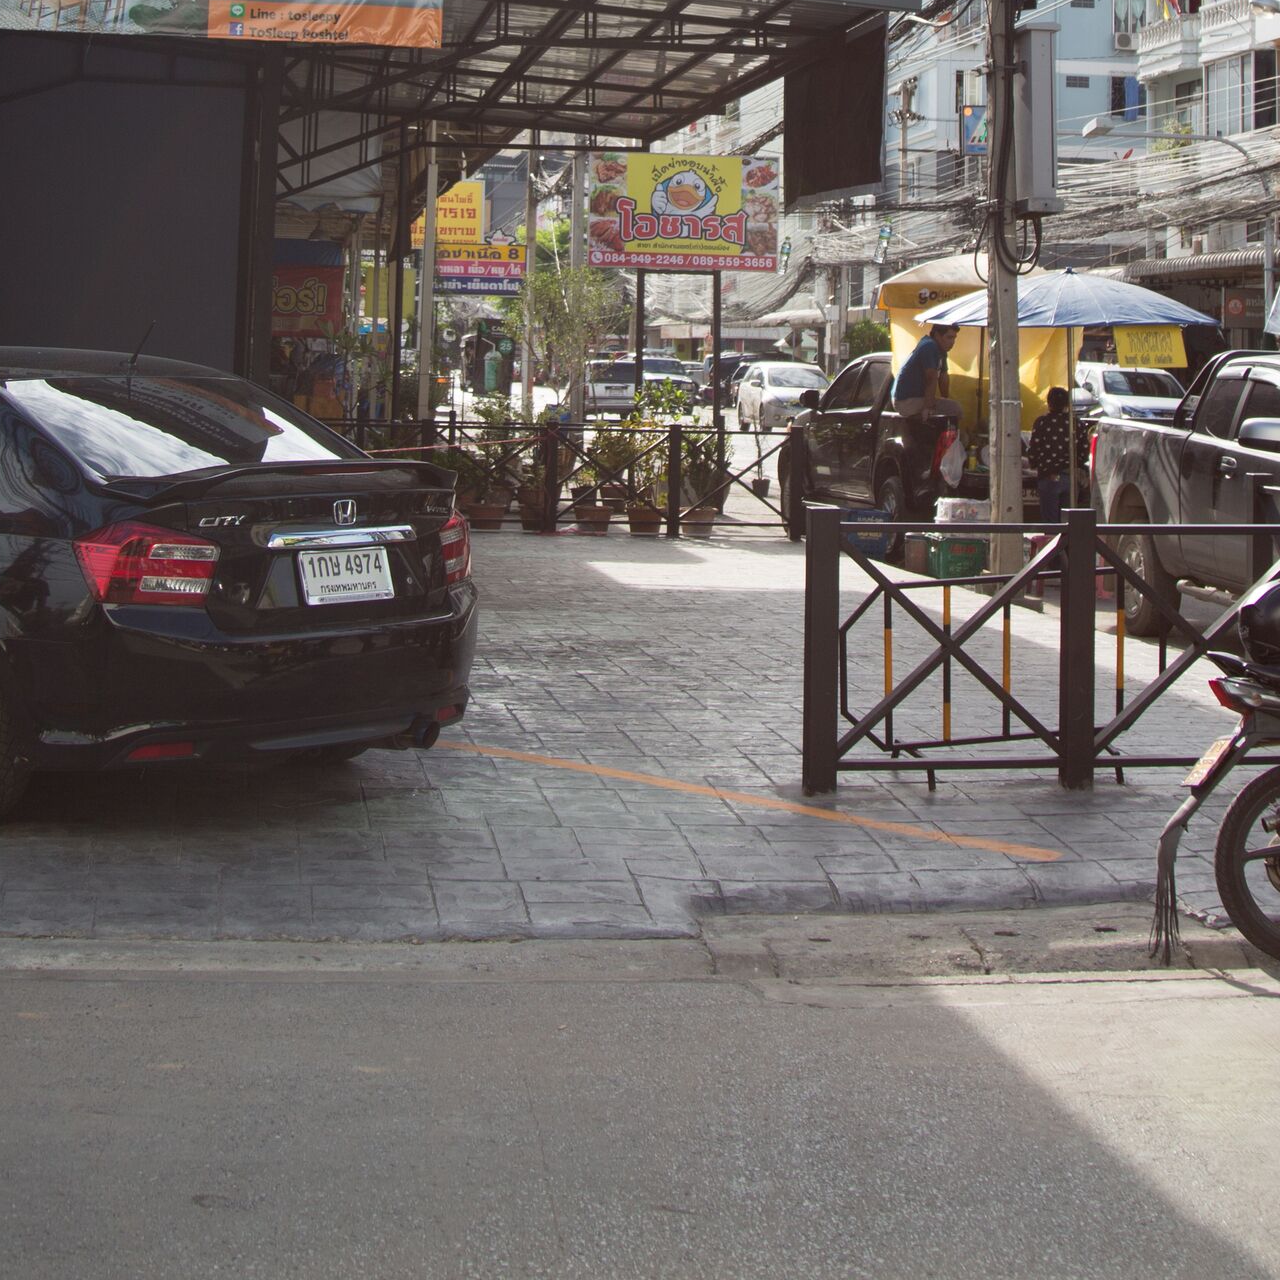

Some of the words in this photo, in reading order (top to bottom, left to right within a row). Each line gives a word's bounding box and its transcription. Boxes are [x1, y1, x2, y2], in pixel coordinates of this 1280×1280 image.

[250, 8, 276, 20] Line
[288, 11, 341, 24] tosleepy
[249, 27, 298, 40] ToSleep
[302, 28, 348, 41] Poshtel
[617, 196, 749, 245] โอชารส
[508, 248, 520, 259] 8
[604, 253, 684, 265] 084-949-2246
[692, 255, 773, 268] 089-559-3656
[500, 342, 513, 351] 25
[199, 515, 245, 527] CITY
[345, 552, 382, 575] 4974
